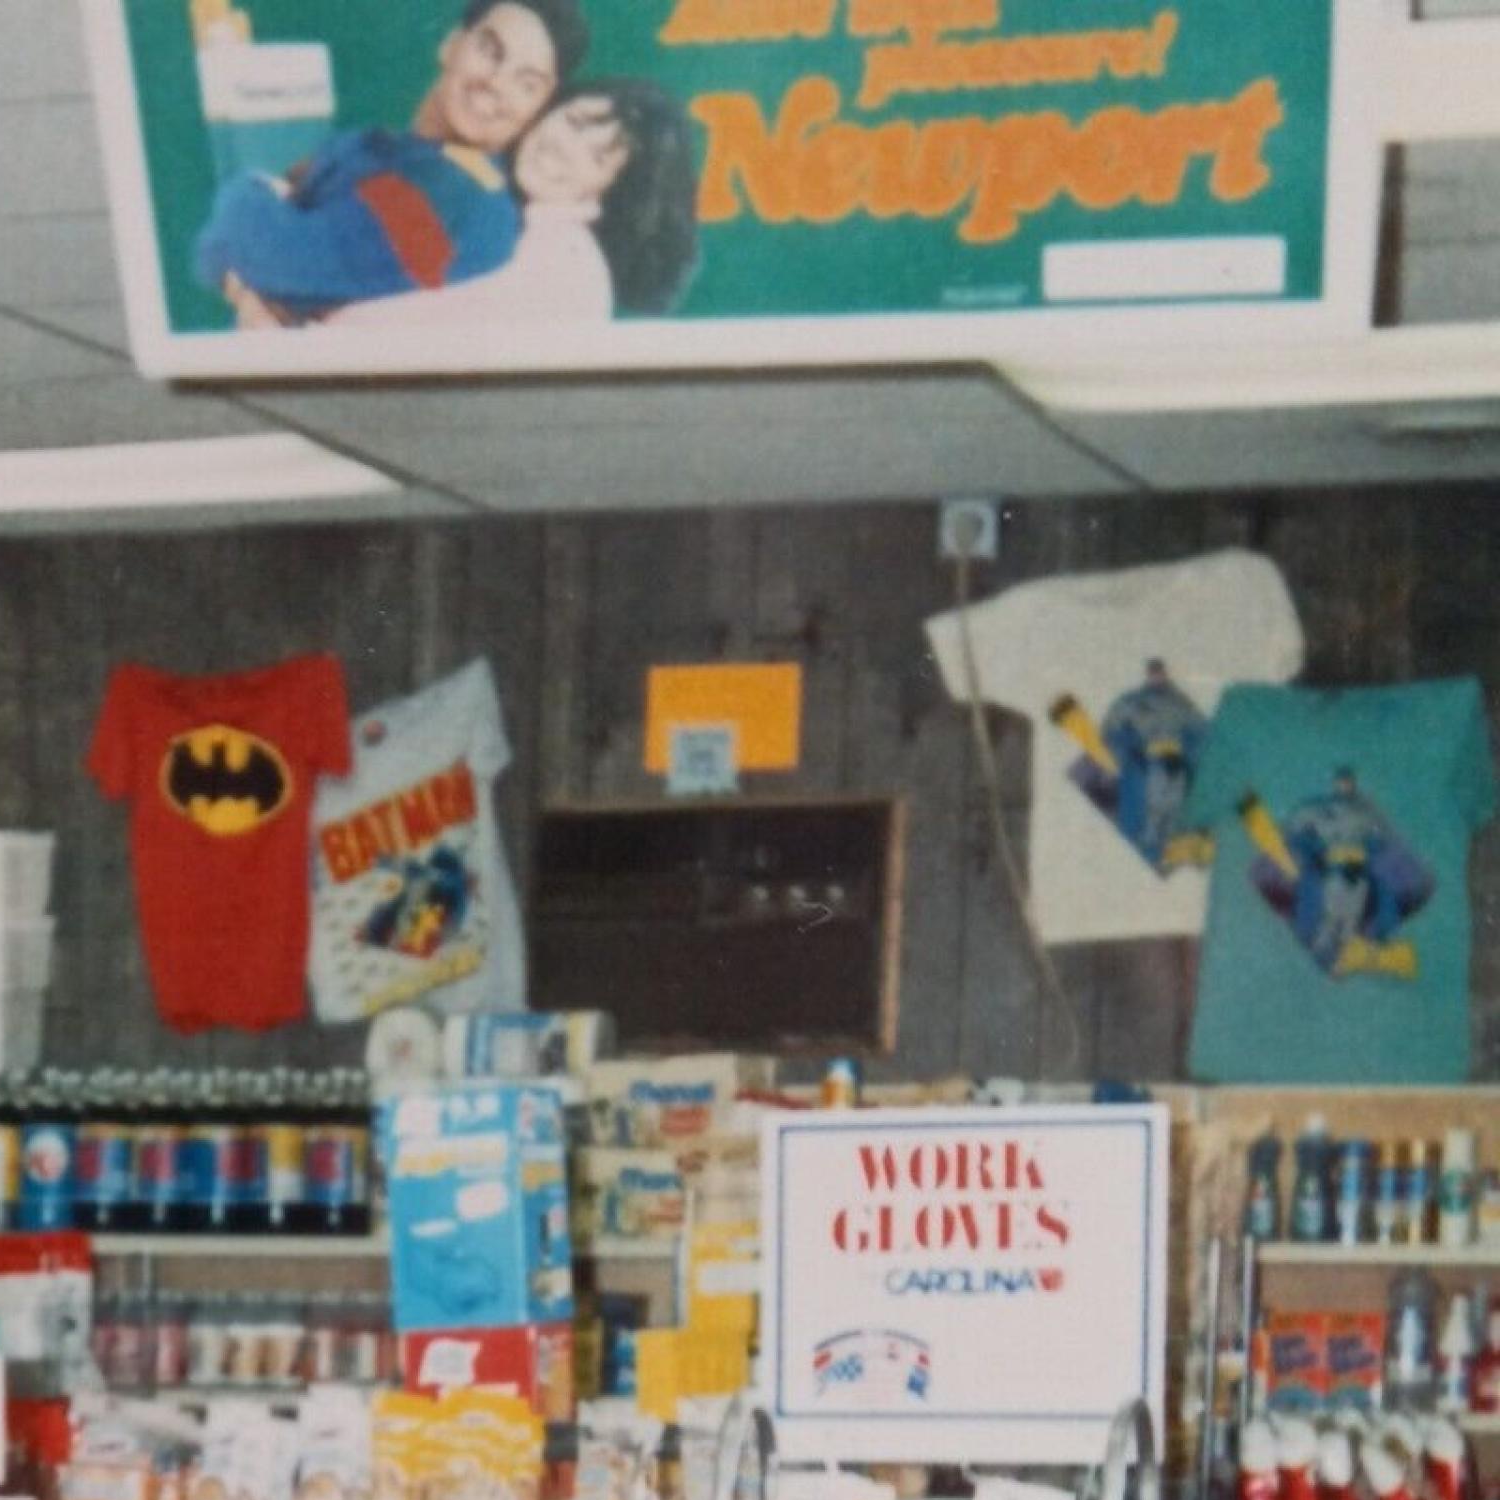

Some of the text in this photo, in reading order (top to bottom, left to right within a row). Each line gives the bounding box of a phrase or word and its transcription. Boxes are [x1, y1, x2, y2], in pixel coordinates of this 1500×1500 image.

[686, 74, 1286, 243] Newport
[318, 762, 480, 886] BATMAN
[857, 1140, 1045, 1193] WORK
[831, 1202, 1072, 1254] GLOVES
